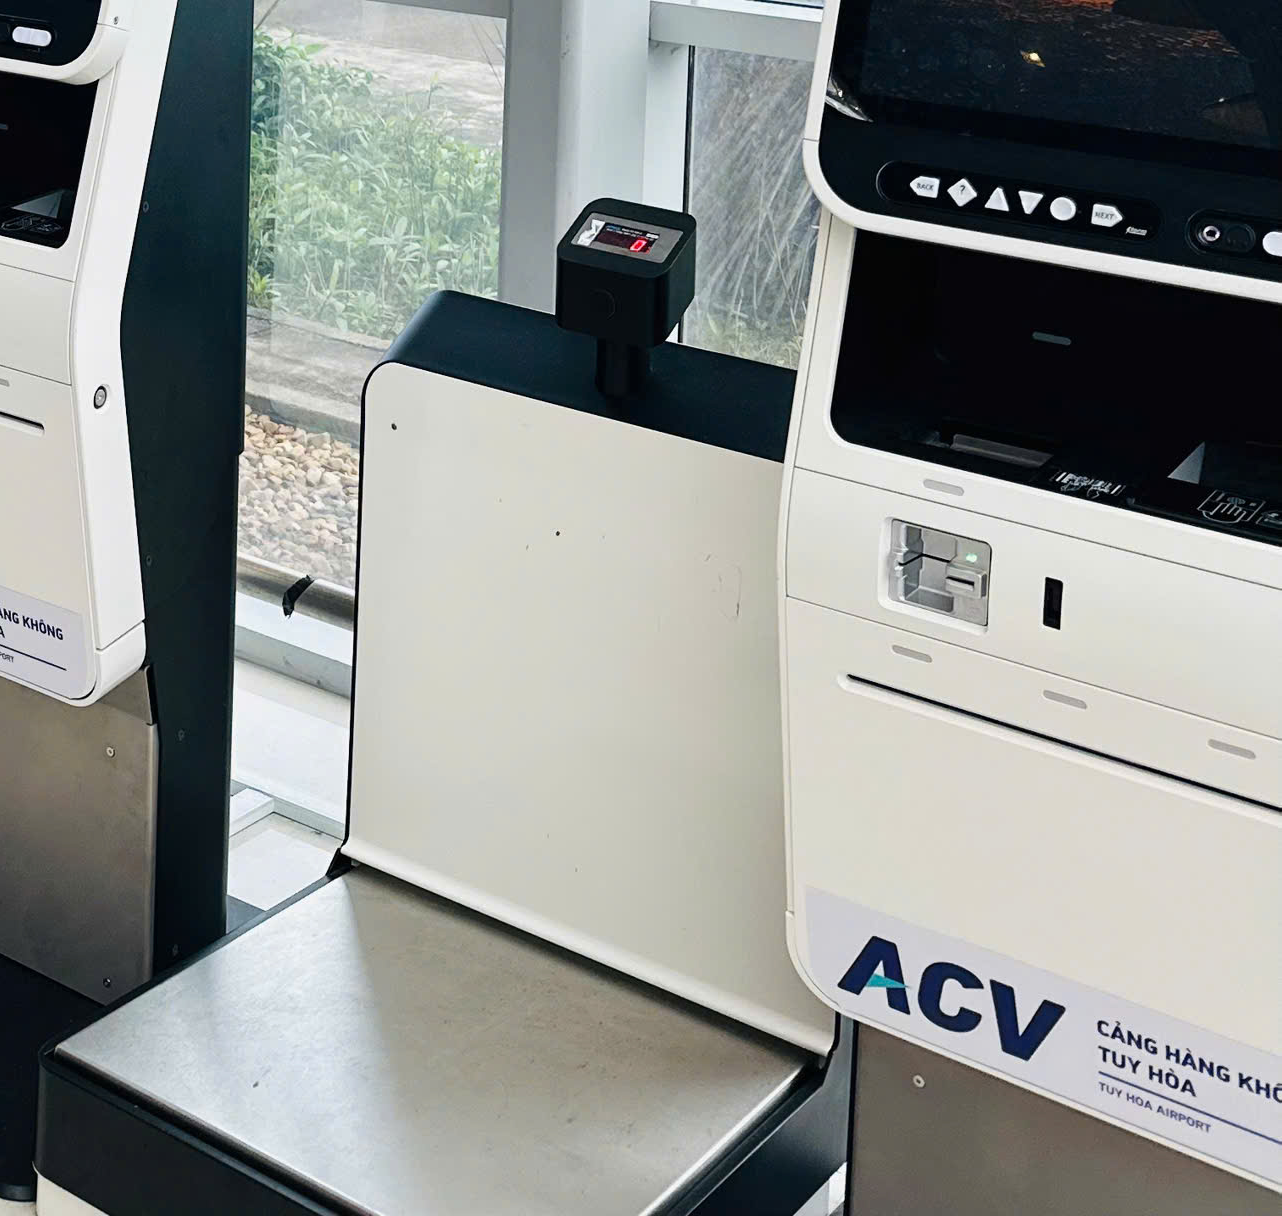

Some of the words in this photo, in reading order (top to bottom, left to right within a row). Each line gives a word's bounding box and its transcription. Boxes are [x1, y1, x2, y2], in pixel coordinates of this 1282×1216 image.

[917, 181, 935, 192] BACK
[1094, 211, 1116, 221] NEXT
[629, 239, 648, 252] 0
[22, 615, 64, 640] KHÔNG
[837, 935, 1066, 1062] ACV
[1097, 1020, 1159, 1055] CẢNG
[1165, 1044, 1231, 1083] HÀNG
[1098, 1045, 1142, 1074] TUY
[1148, 1065, 1198, 1098] HÒA
[1099, 1081, 1123, 1099] TUY
[1126, 1092, 1154, 1111] HOA
[1156, 1105, 1212, 1133] AIRPORT
